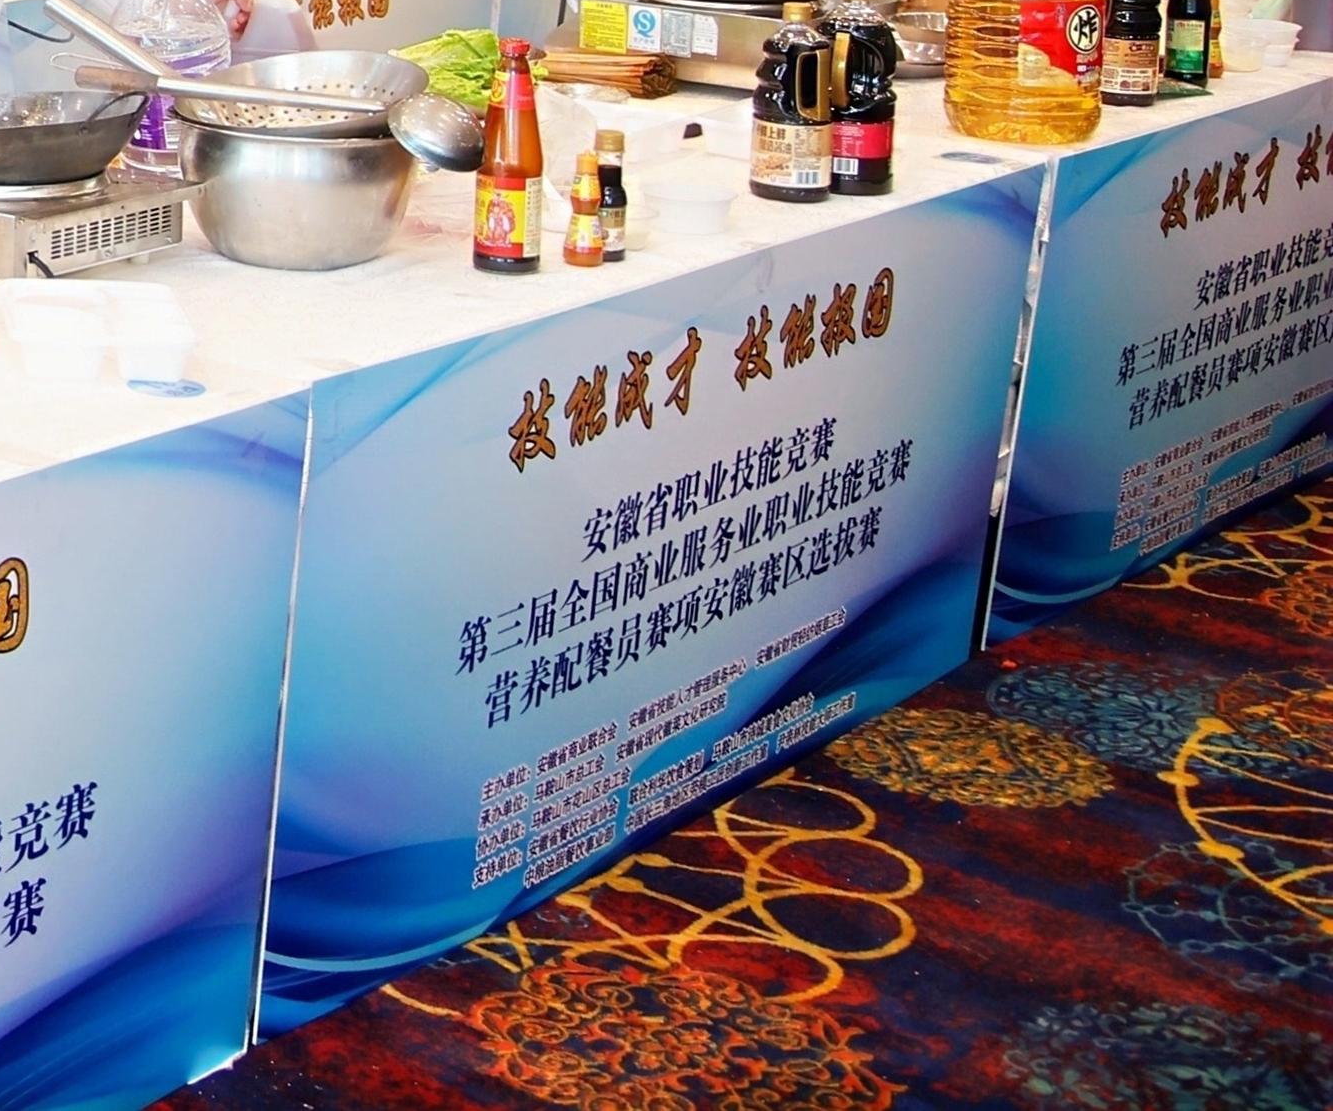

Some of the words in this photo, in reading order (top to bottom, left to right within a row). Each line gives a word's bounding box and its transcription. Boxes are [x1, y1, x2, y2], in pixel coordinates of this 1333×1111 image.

[1073, 9, 1098, 45] 炸
[1160, 136, 1279, 239] 技能成才
[507, 325, 702, 474] 技能成才
[733, 266, 896, 392] 技能报国
[454, 438, 914, 676] 第三届全国商业服务业职业技能竞赛
[581, 417, 837, 564] 安徽省职业技能竞赛
[484, 506, 884, 729] 营养配餐员赛项安徽赛区选拔赛
